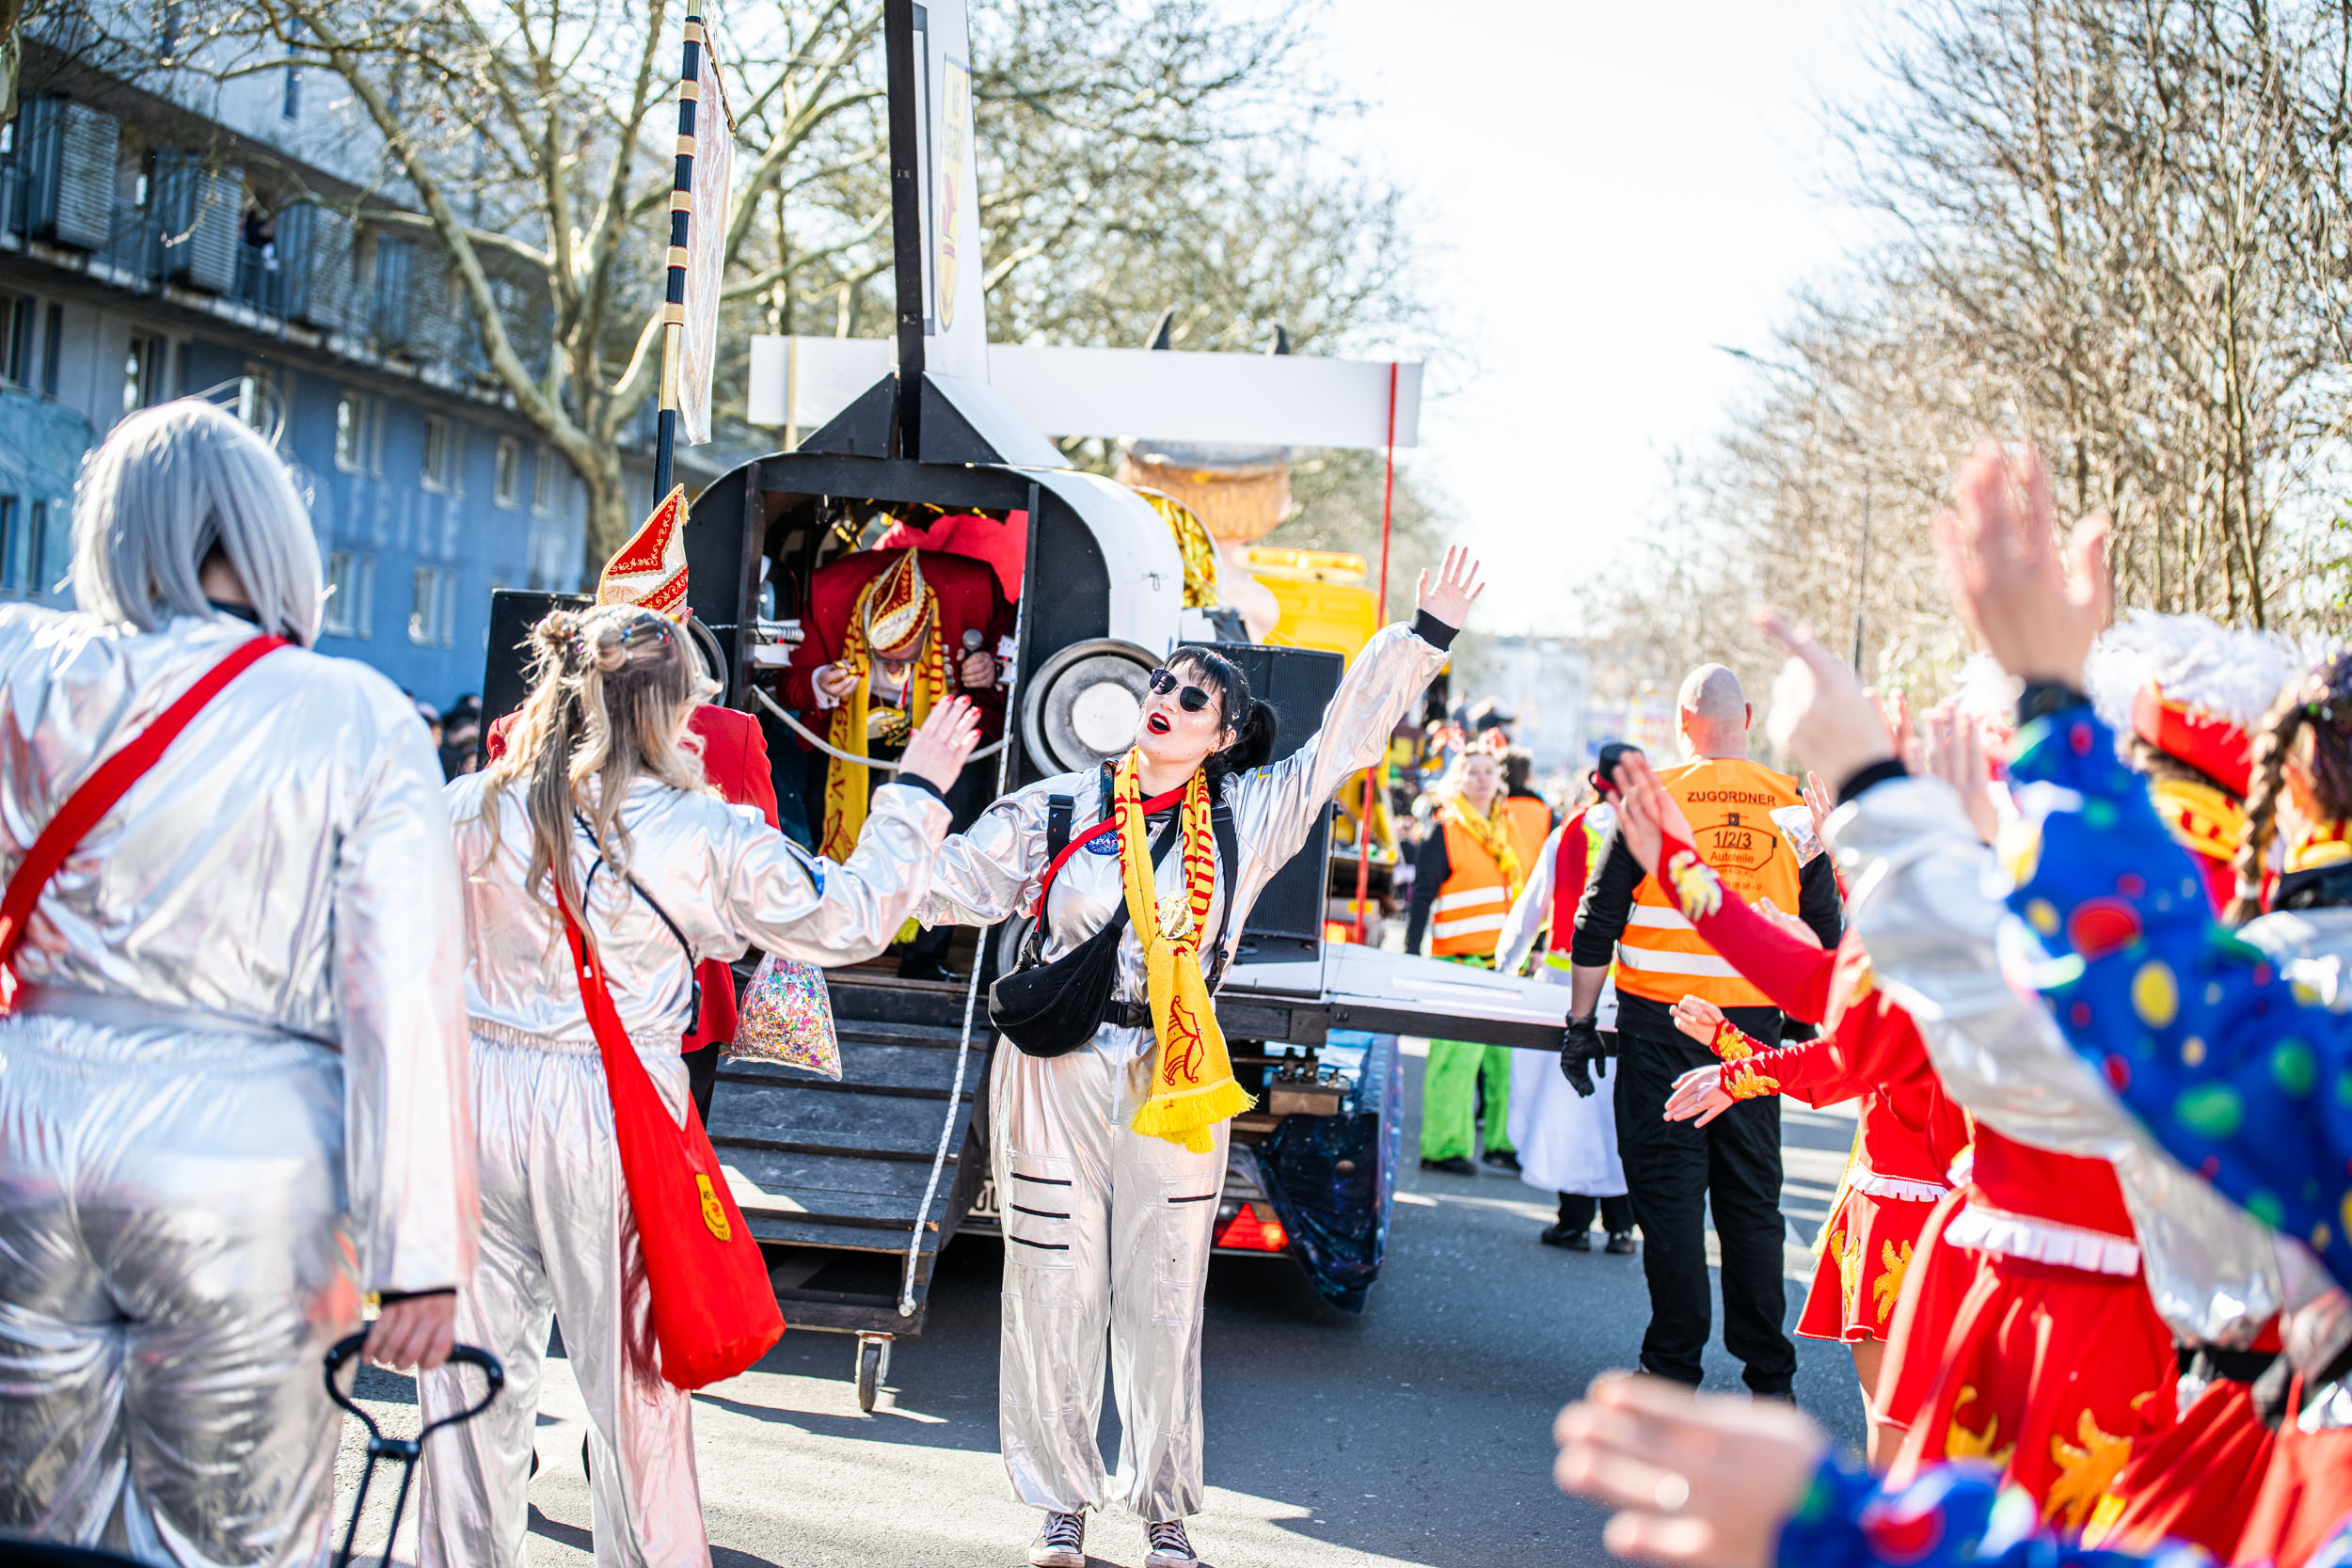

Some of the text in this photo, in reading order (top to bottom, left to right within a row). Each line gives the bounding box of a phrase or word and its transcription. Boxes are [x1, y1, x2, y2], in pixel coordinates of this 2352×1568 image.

[1687, 791, 1776, 806] ZUGORDNER
[1714, 831, 1752, 848] 1/2/3
[1710, 851, 1755, 863] Autoteile
